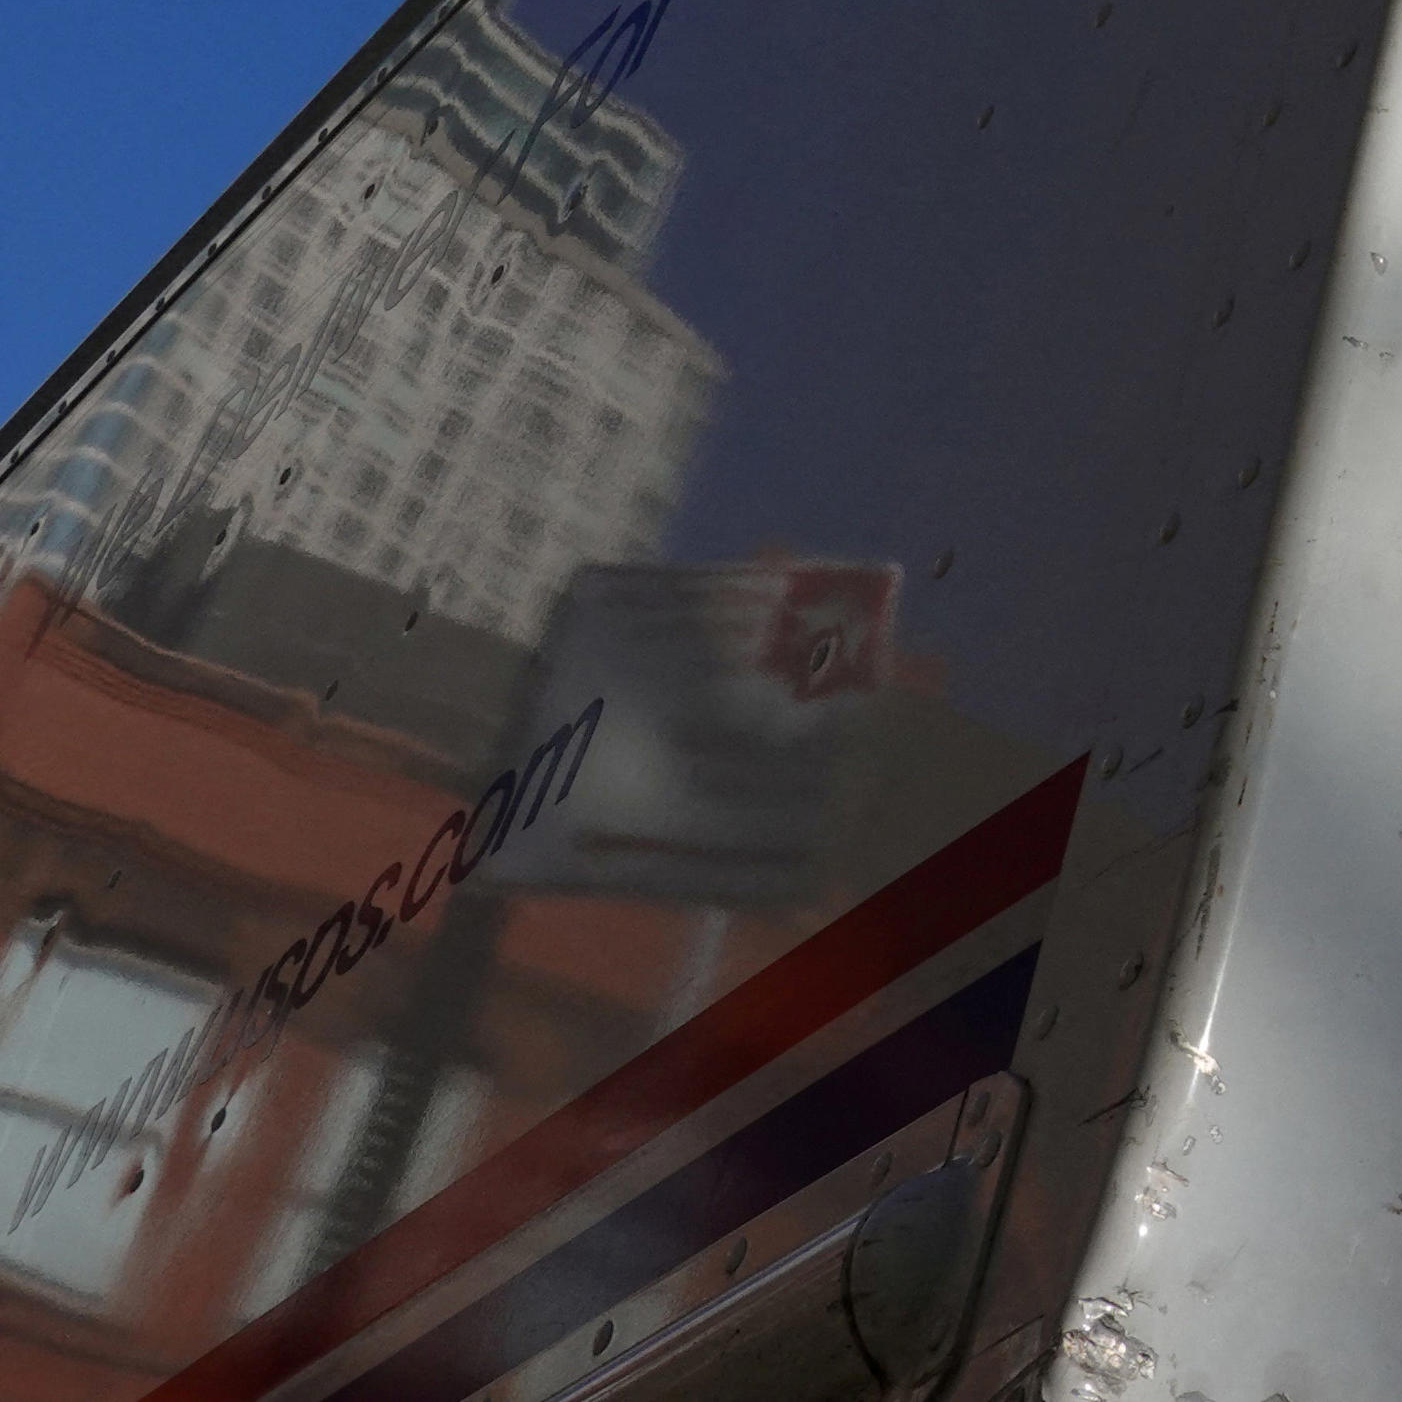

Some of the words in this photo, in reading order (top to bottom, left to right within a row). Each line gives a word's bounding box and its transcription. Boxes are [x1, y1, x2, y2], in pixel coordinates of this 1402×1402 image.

[25, 466, 164, 661] We
[152, 129, 517, 538] Deliver
[8, 698, 604, 1235] www.usps.com
